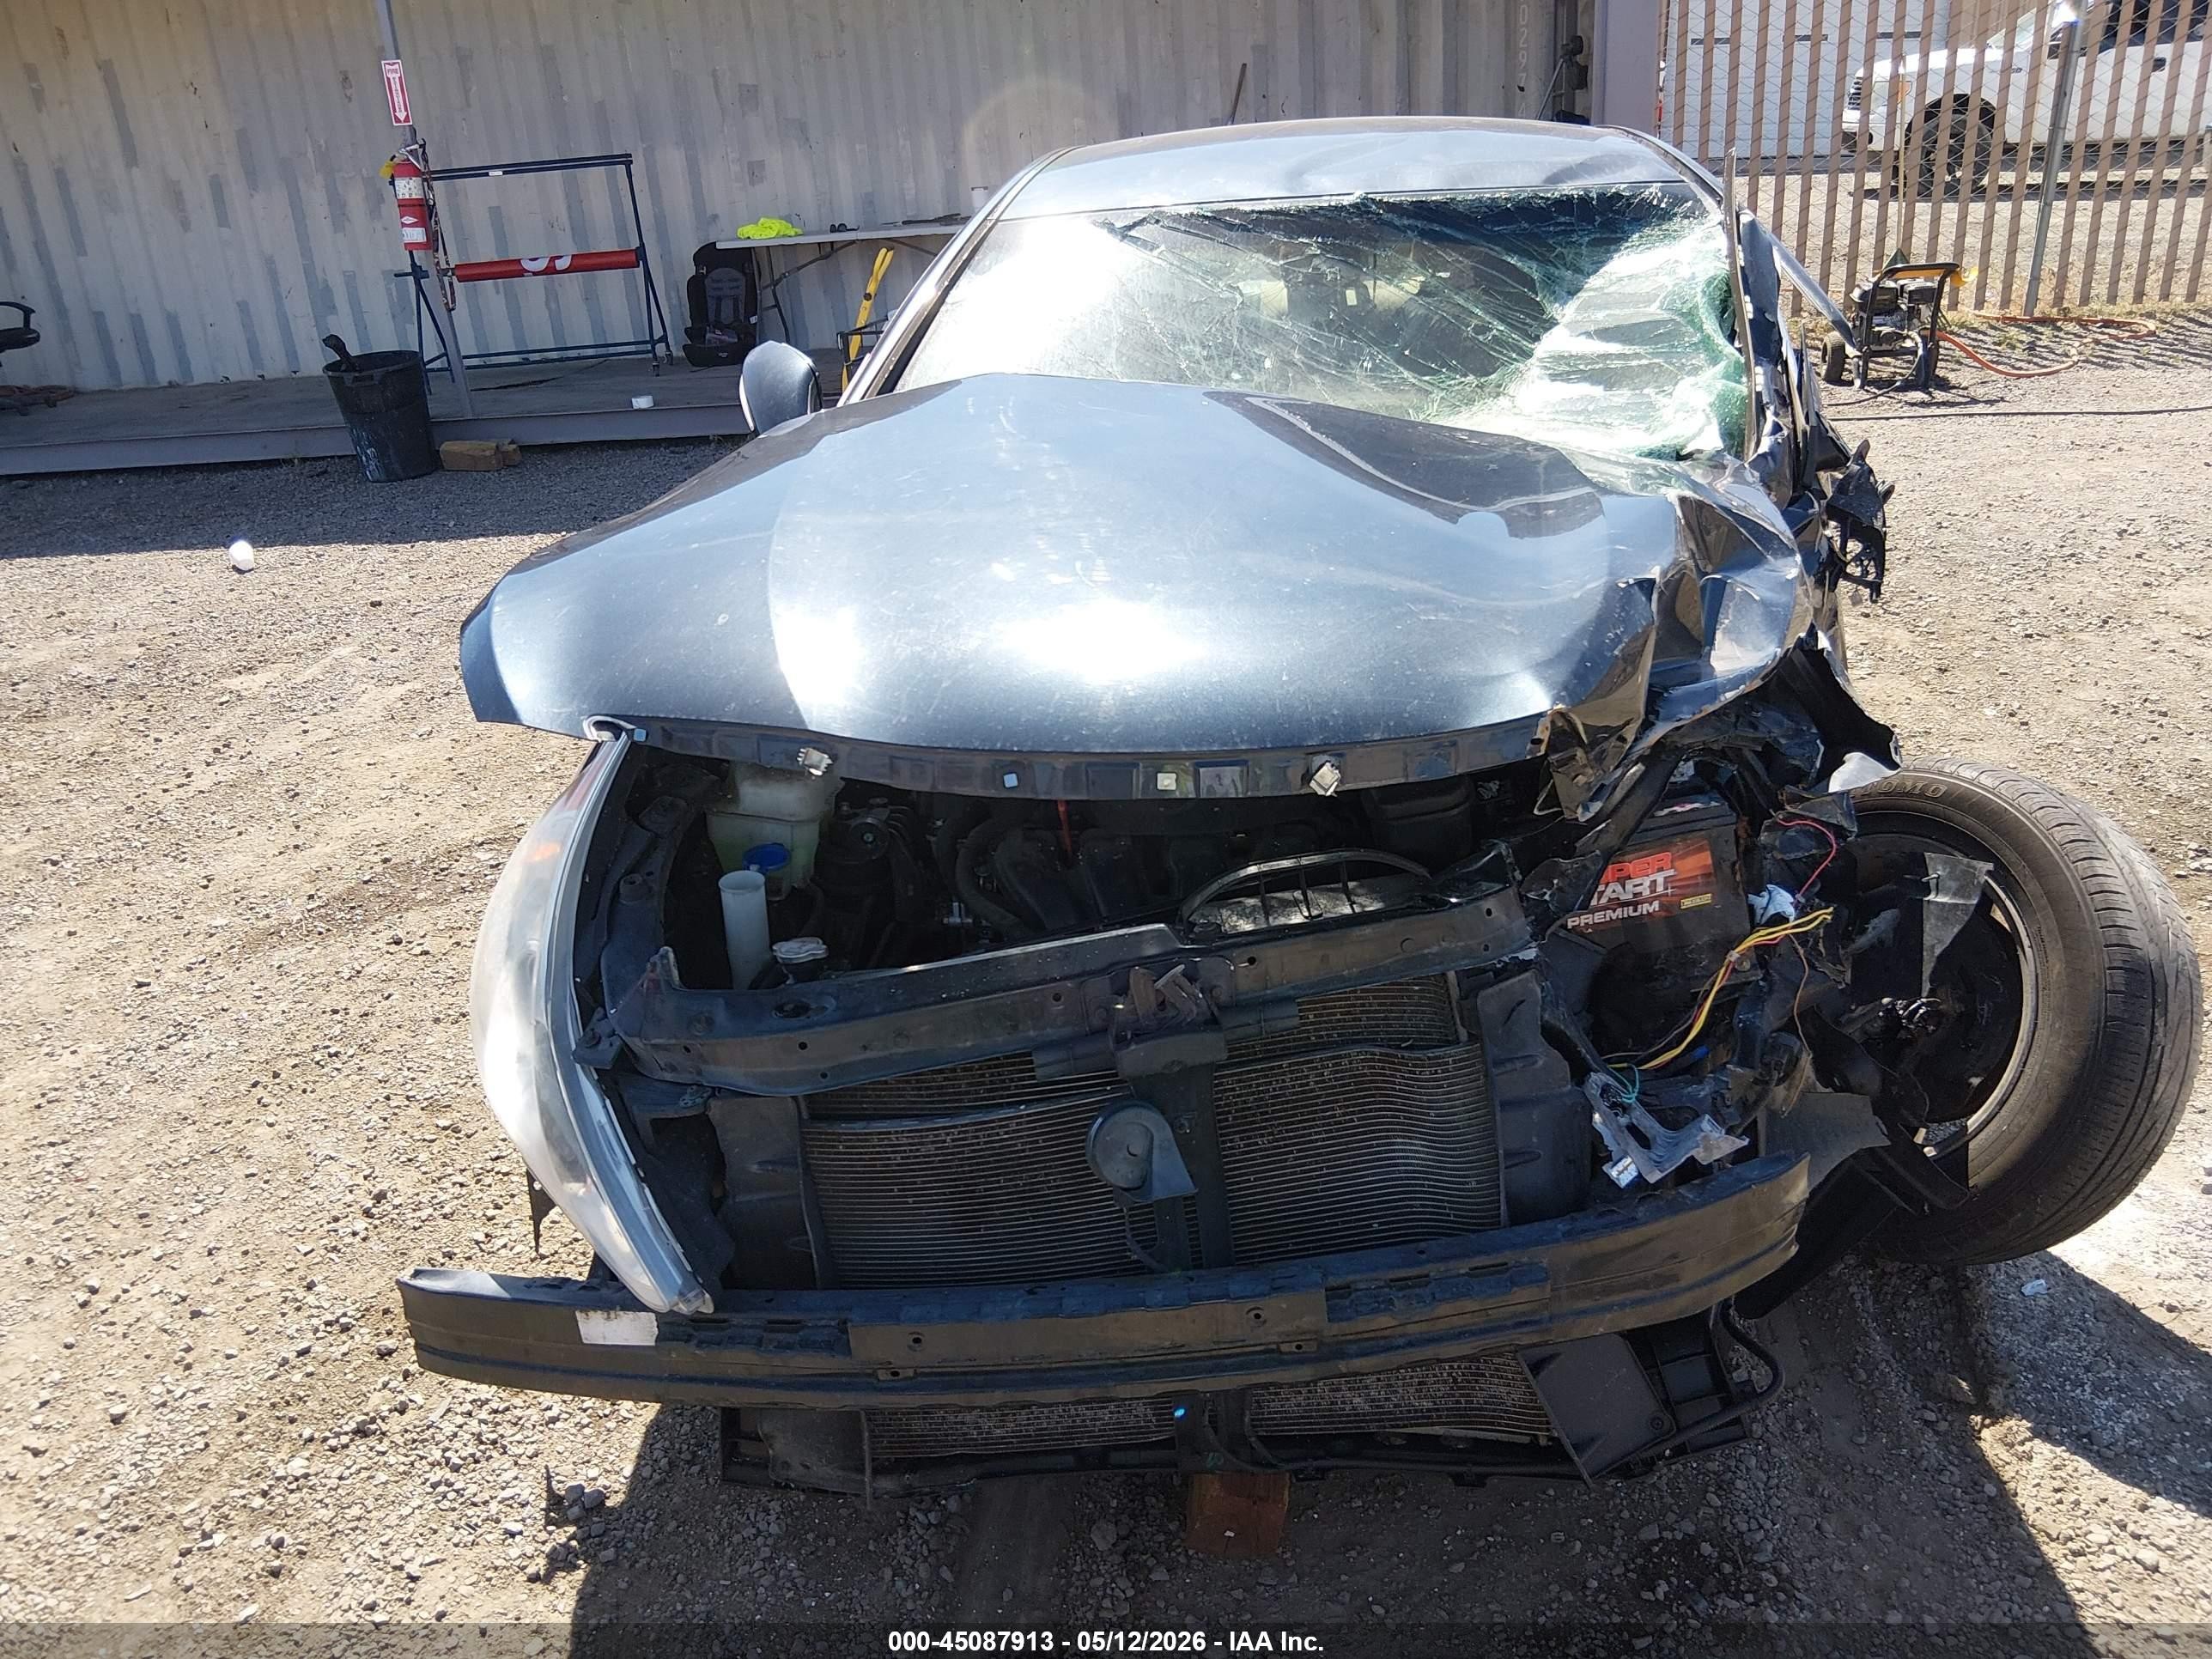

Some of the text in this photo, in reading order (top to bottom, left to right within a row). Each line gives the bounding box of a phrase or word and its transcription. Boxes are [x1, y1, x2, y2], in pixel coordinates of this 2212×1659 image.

[1518, 0, 1529, 92] 0297
[1850, 779, 1948, 799] TOMO
[1600, 853, 1672, 883] PER
[1590, 869, 1676, 906] TART
[1566, 900, 1660, 929] PREMIUM
